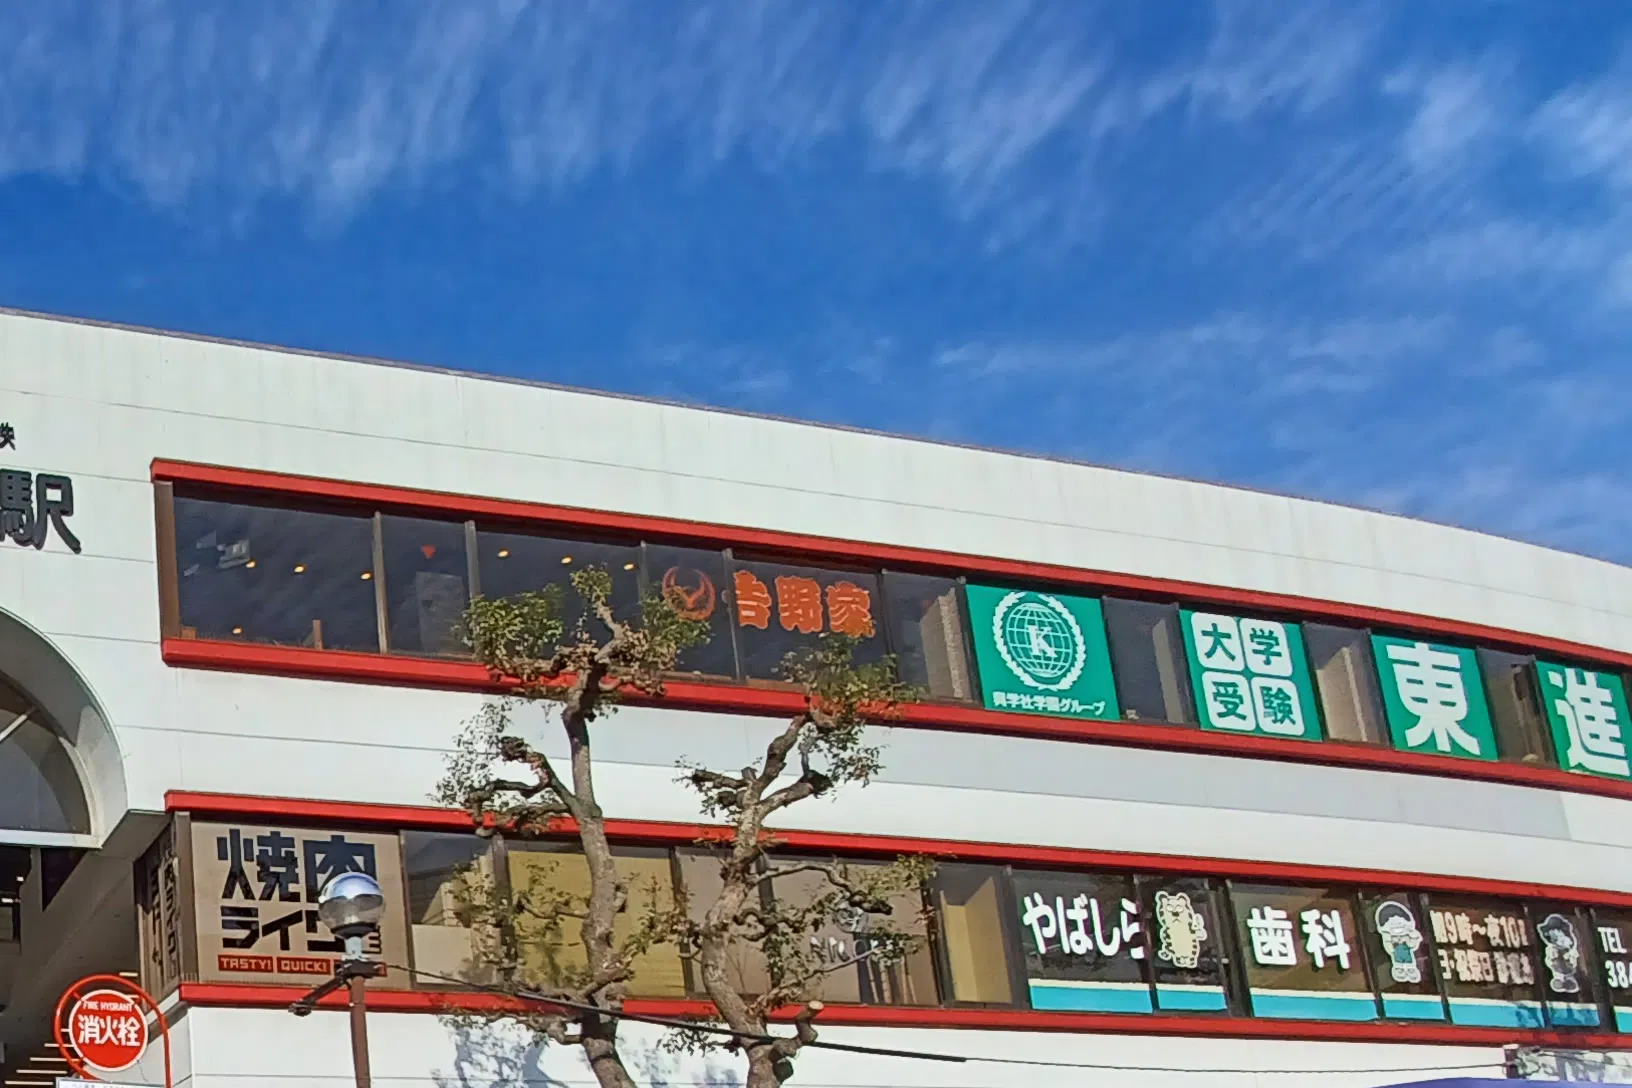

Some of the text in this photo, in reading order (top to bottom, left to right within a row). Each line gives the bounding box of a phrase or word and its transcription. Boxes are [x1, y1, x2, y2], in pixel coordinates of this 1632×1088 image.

[734, 569, 876, 637] 吉野家
[1200, 622, 1285, 665] 大学
[1212, 680, 1304, 729] 受験
[216, 828, 378, 904] 焼肉
[1023, 891, 1351, 969] やばしら 歯科
[1597, 926, 1628, 954] TEL
[220, 957, 272, 969] TASTY!
[280, 958, 328, 972] QUICK!
[83, 1001, 133, 1012] FIRE HYDRANT
[78, 1014, 141, 1047] 消火栓
